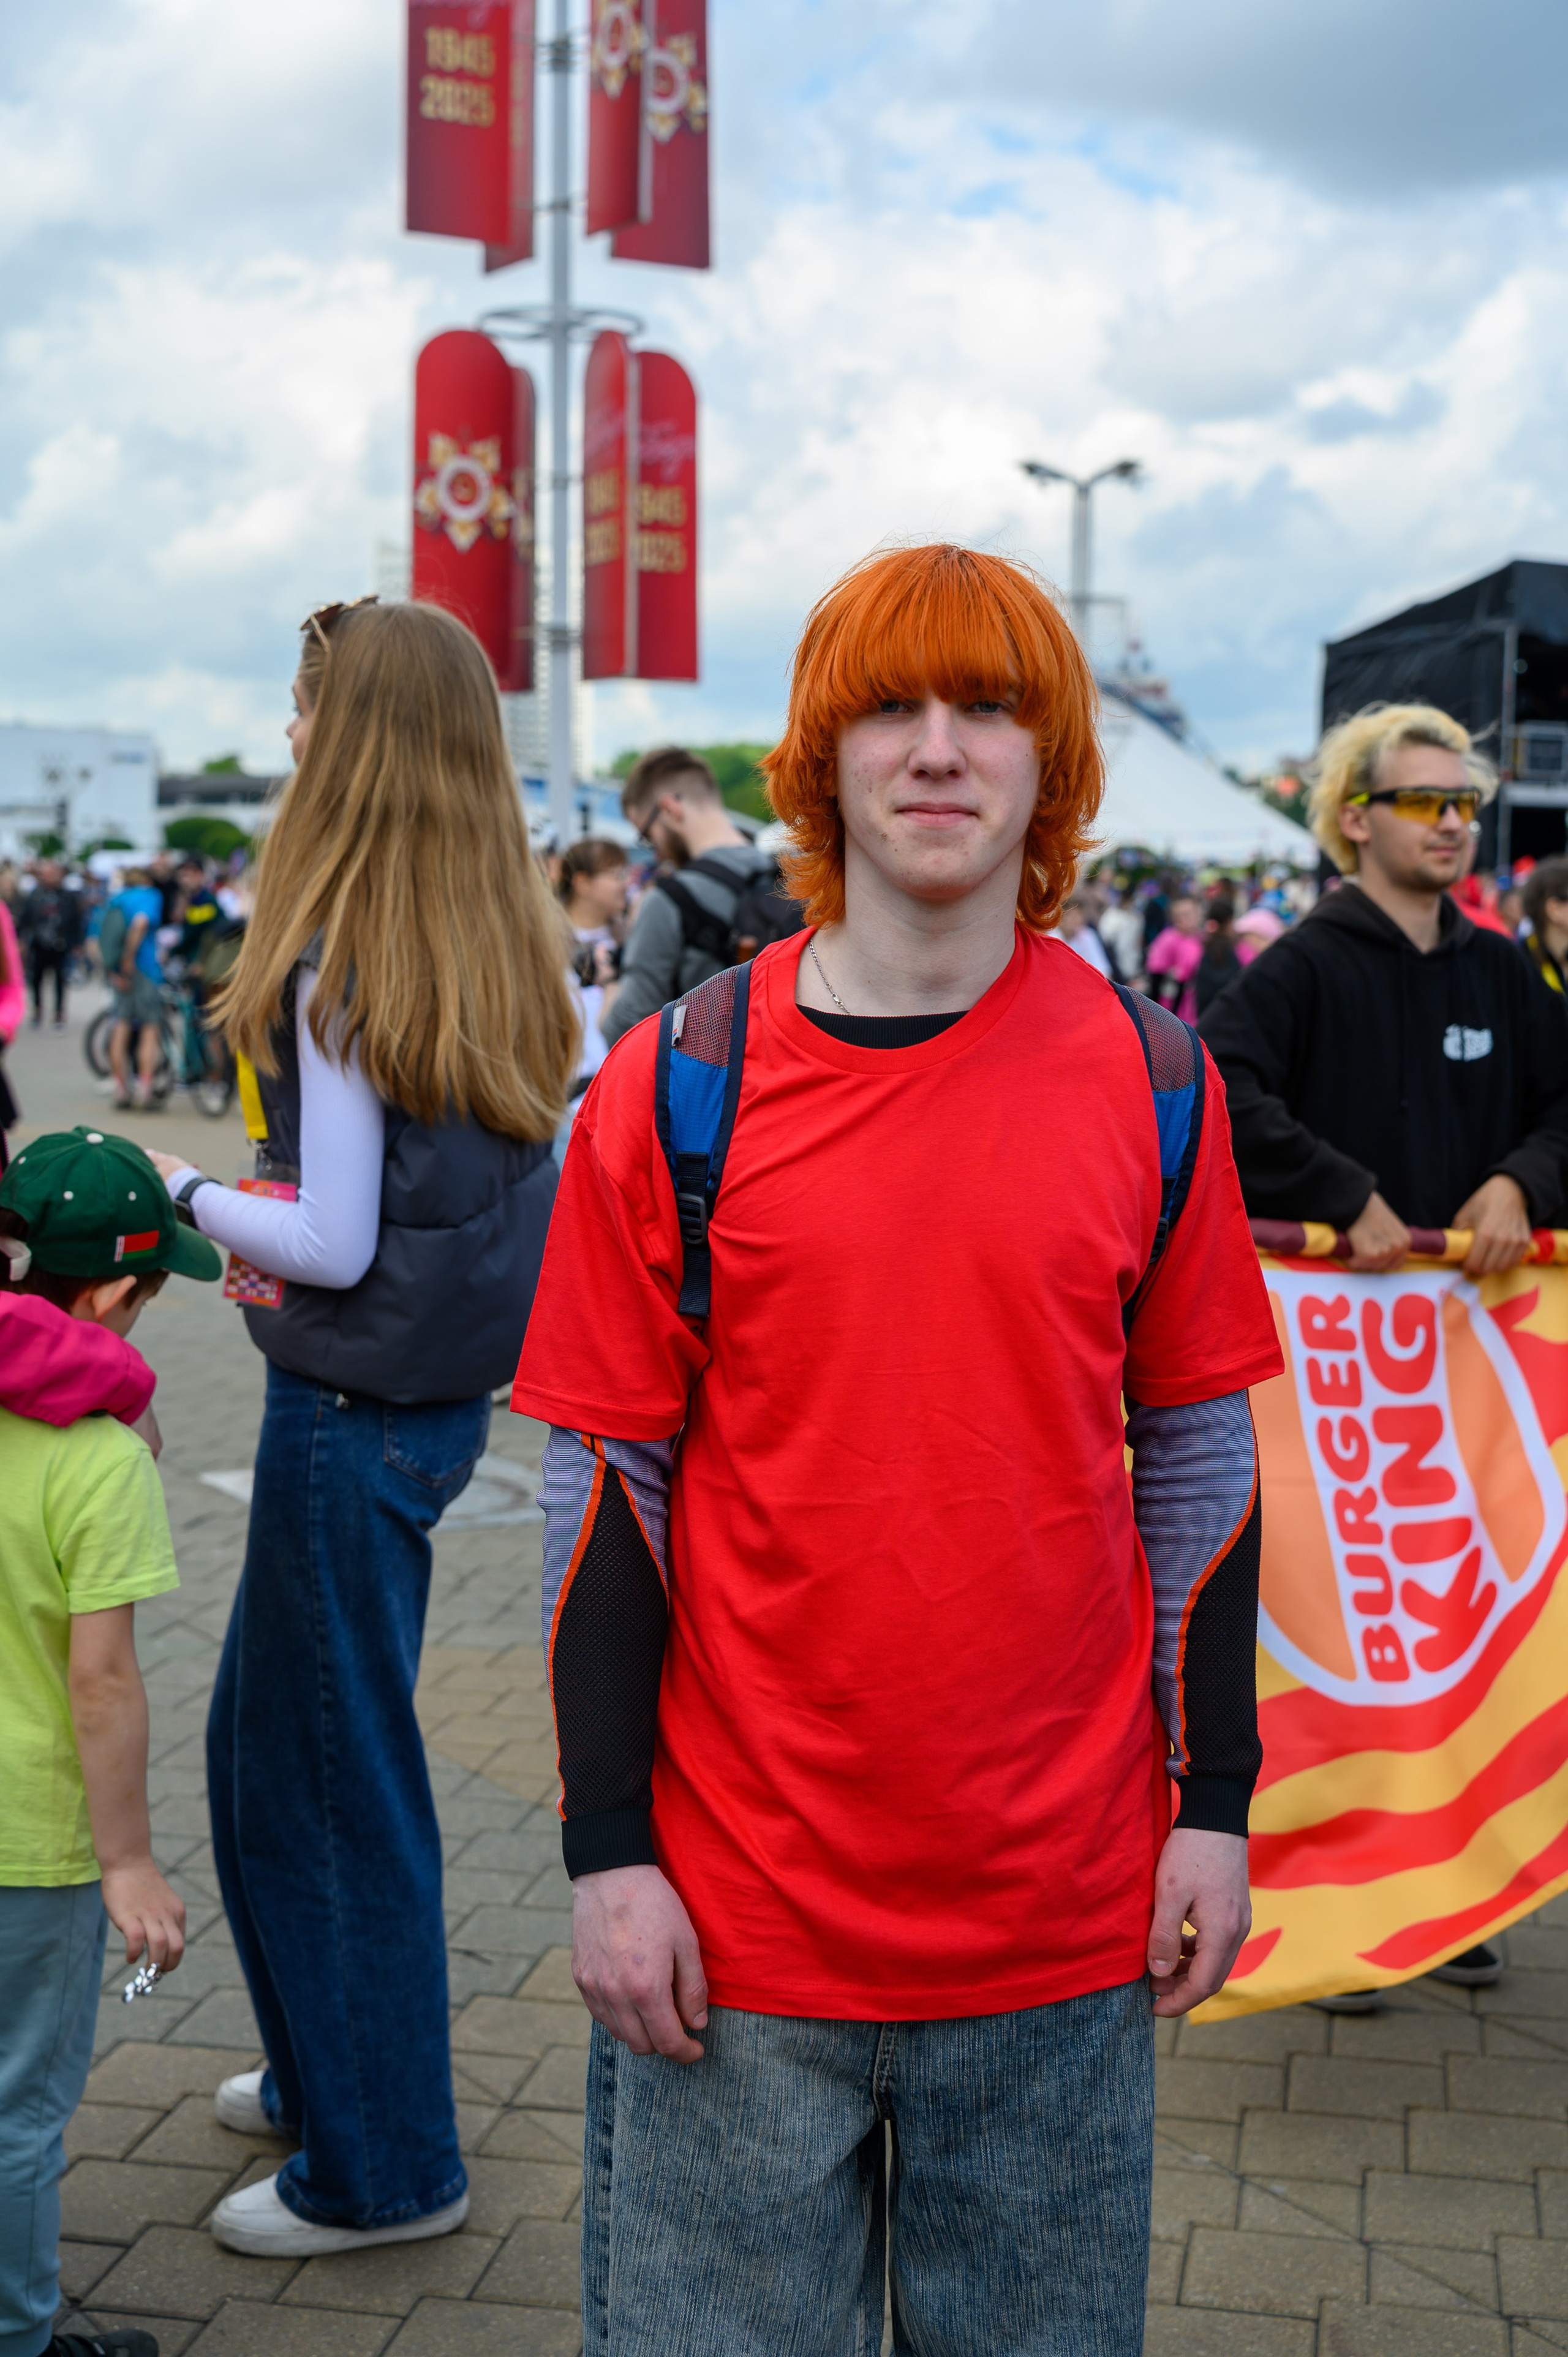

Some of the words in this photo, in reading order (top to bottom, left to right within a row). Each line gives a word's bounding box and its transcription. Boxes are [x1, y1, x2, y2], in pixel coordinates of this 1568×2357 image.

[421, 75, 494, 127] 2025
[426, 28, 494, 76] 1945
[1298, 1294, 1410, 1682] BURGER
[1361, 1293, 1497, 1673] KING
